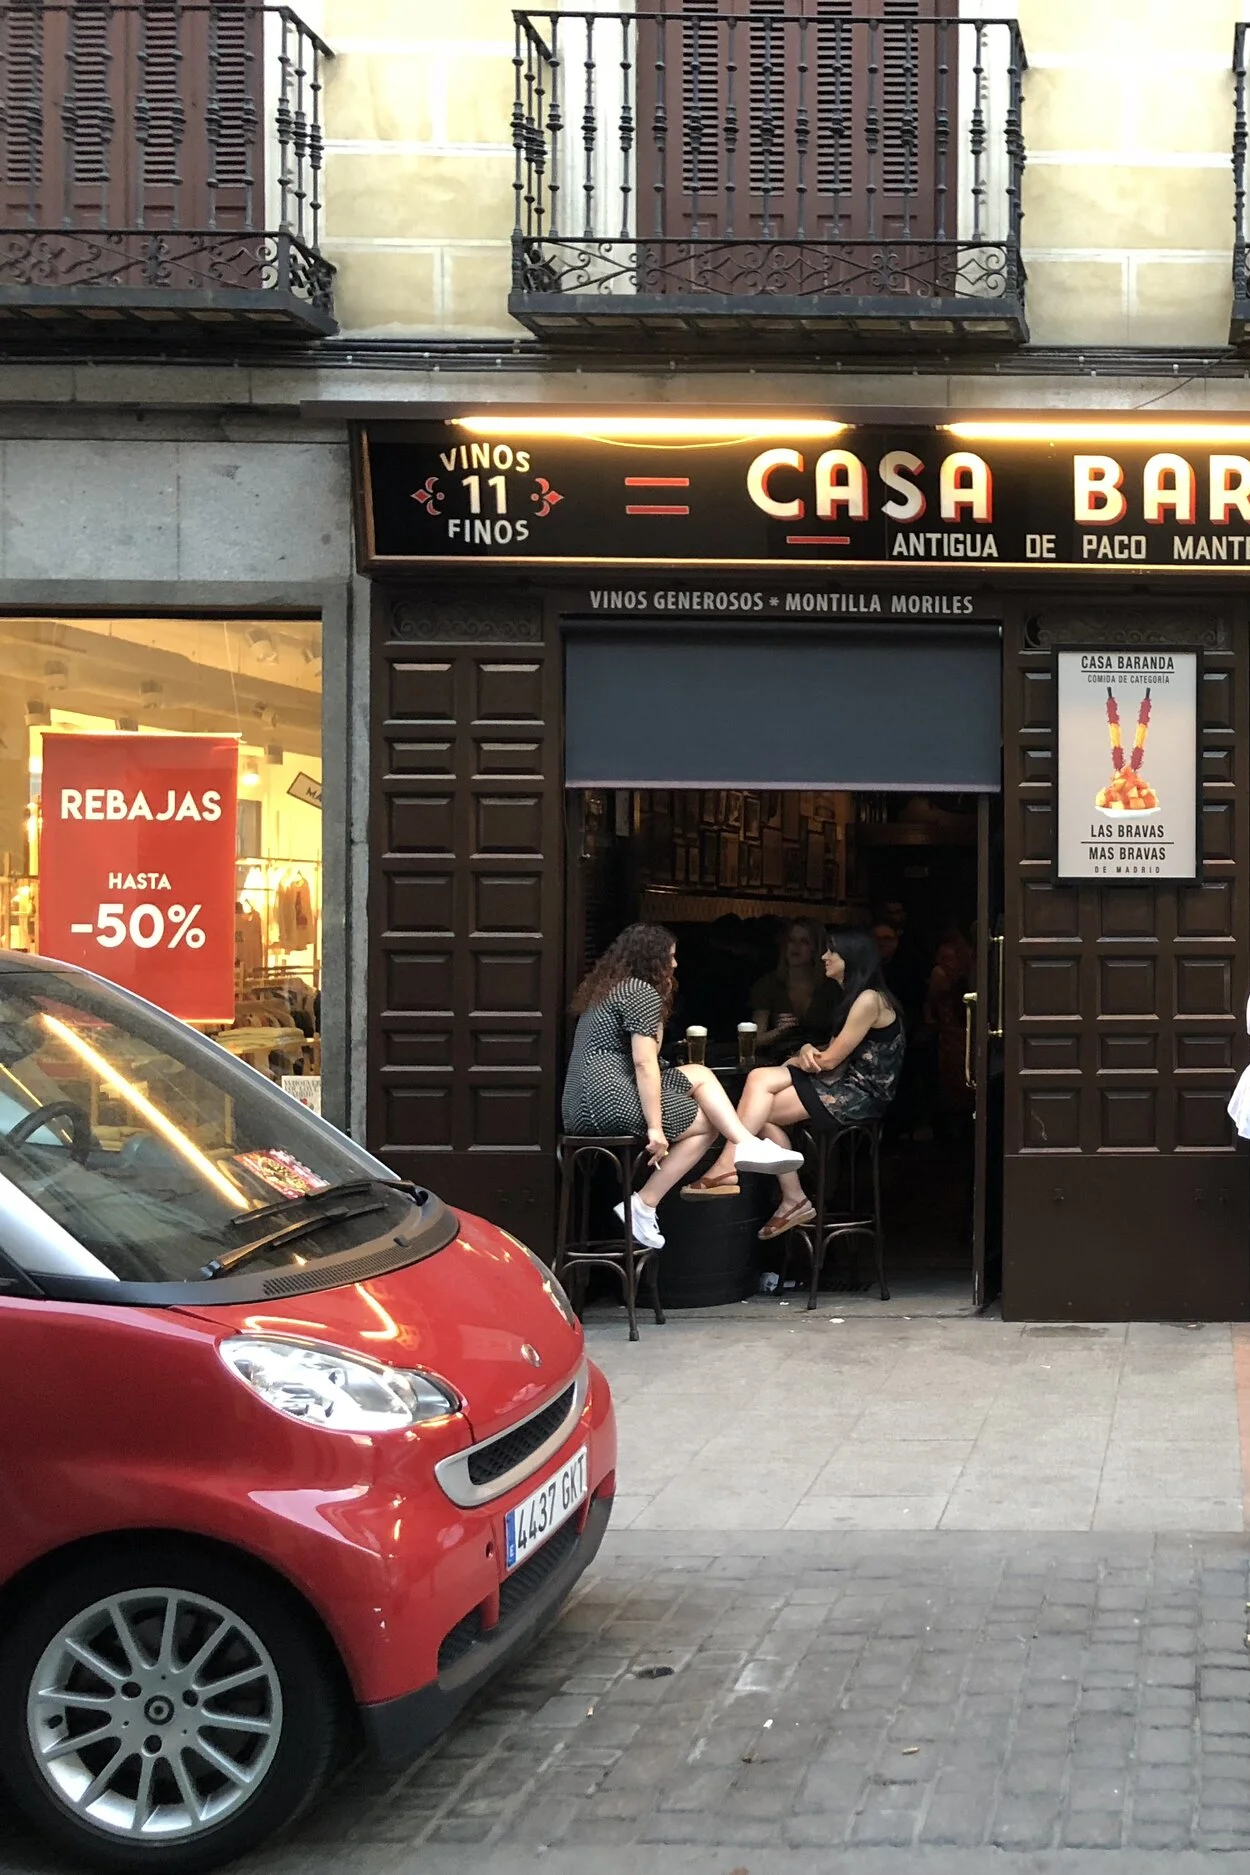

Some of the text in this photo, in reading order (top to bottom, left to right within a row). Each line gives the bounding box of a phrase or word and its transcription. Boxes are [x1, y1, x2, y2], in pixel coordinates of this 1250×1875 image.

[439, 442, 531, 473] VINOS
[461, 475, 507, 514] 11
[746, 448, 994, 522] CASA
[448, 518, 529, 545] FINOS
[891, 532, 998, 558] ANTIGUA
[1025, 535, 1057, 559] DE
[1082, 535, 1147, 560] PACO
[590, 591, 973, 614] VINOS GENEROSOS MONTILLA MORILES
[1081, 655, 1175, 670] CASA BARANDA
[1087, 674, 1116, 684] COMIDA
[1118, 674, 1128, 684] DE
[61, 788, 222, 822] REBAJAS
[1091, 824, 1165, 838] LAS BRAVAS
[1089, 846, 1166, 861] MAS BRAVAS
[108, 872, 172, 890] HASTA
[1094, 865, 1160, 874] DE MADRID
[71, 903, 206, 949] -50%
[517, 1454, 584, 1550] 4437 GKT
